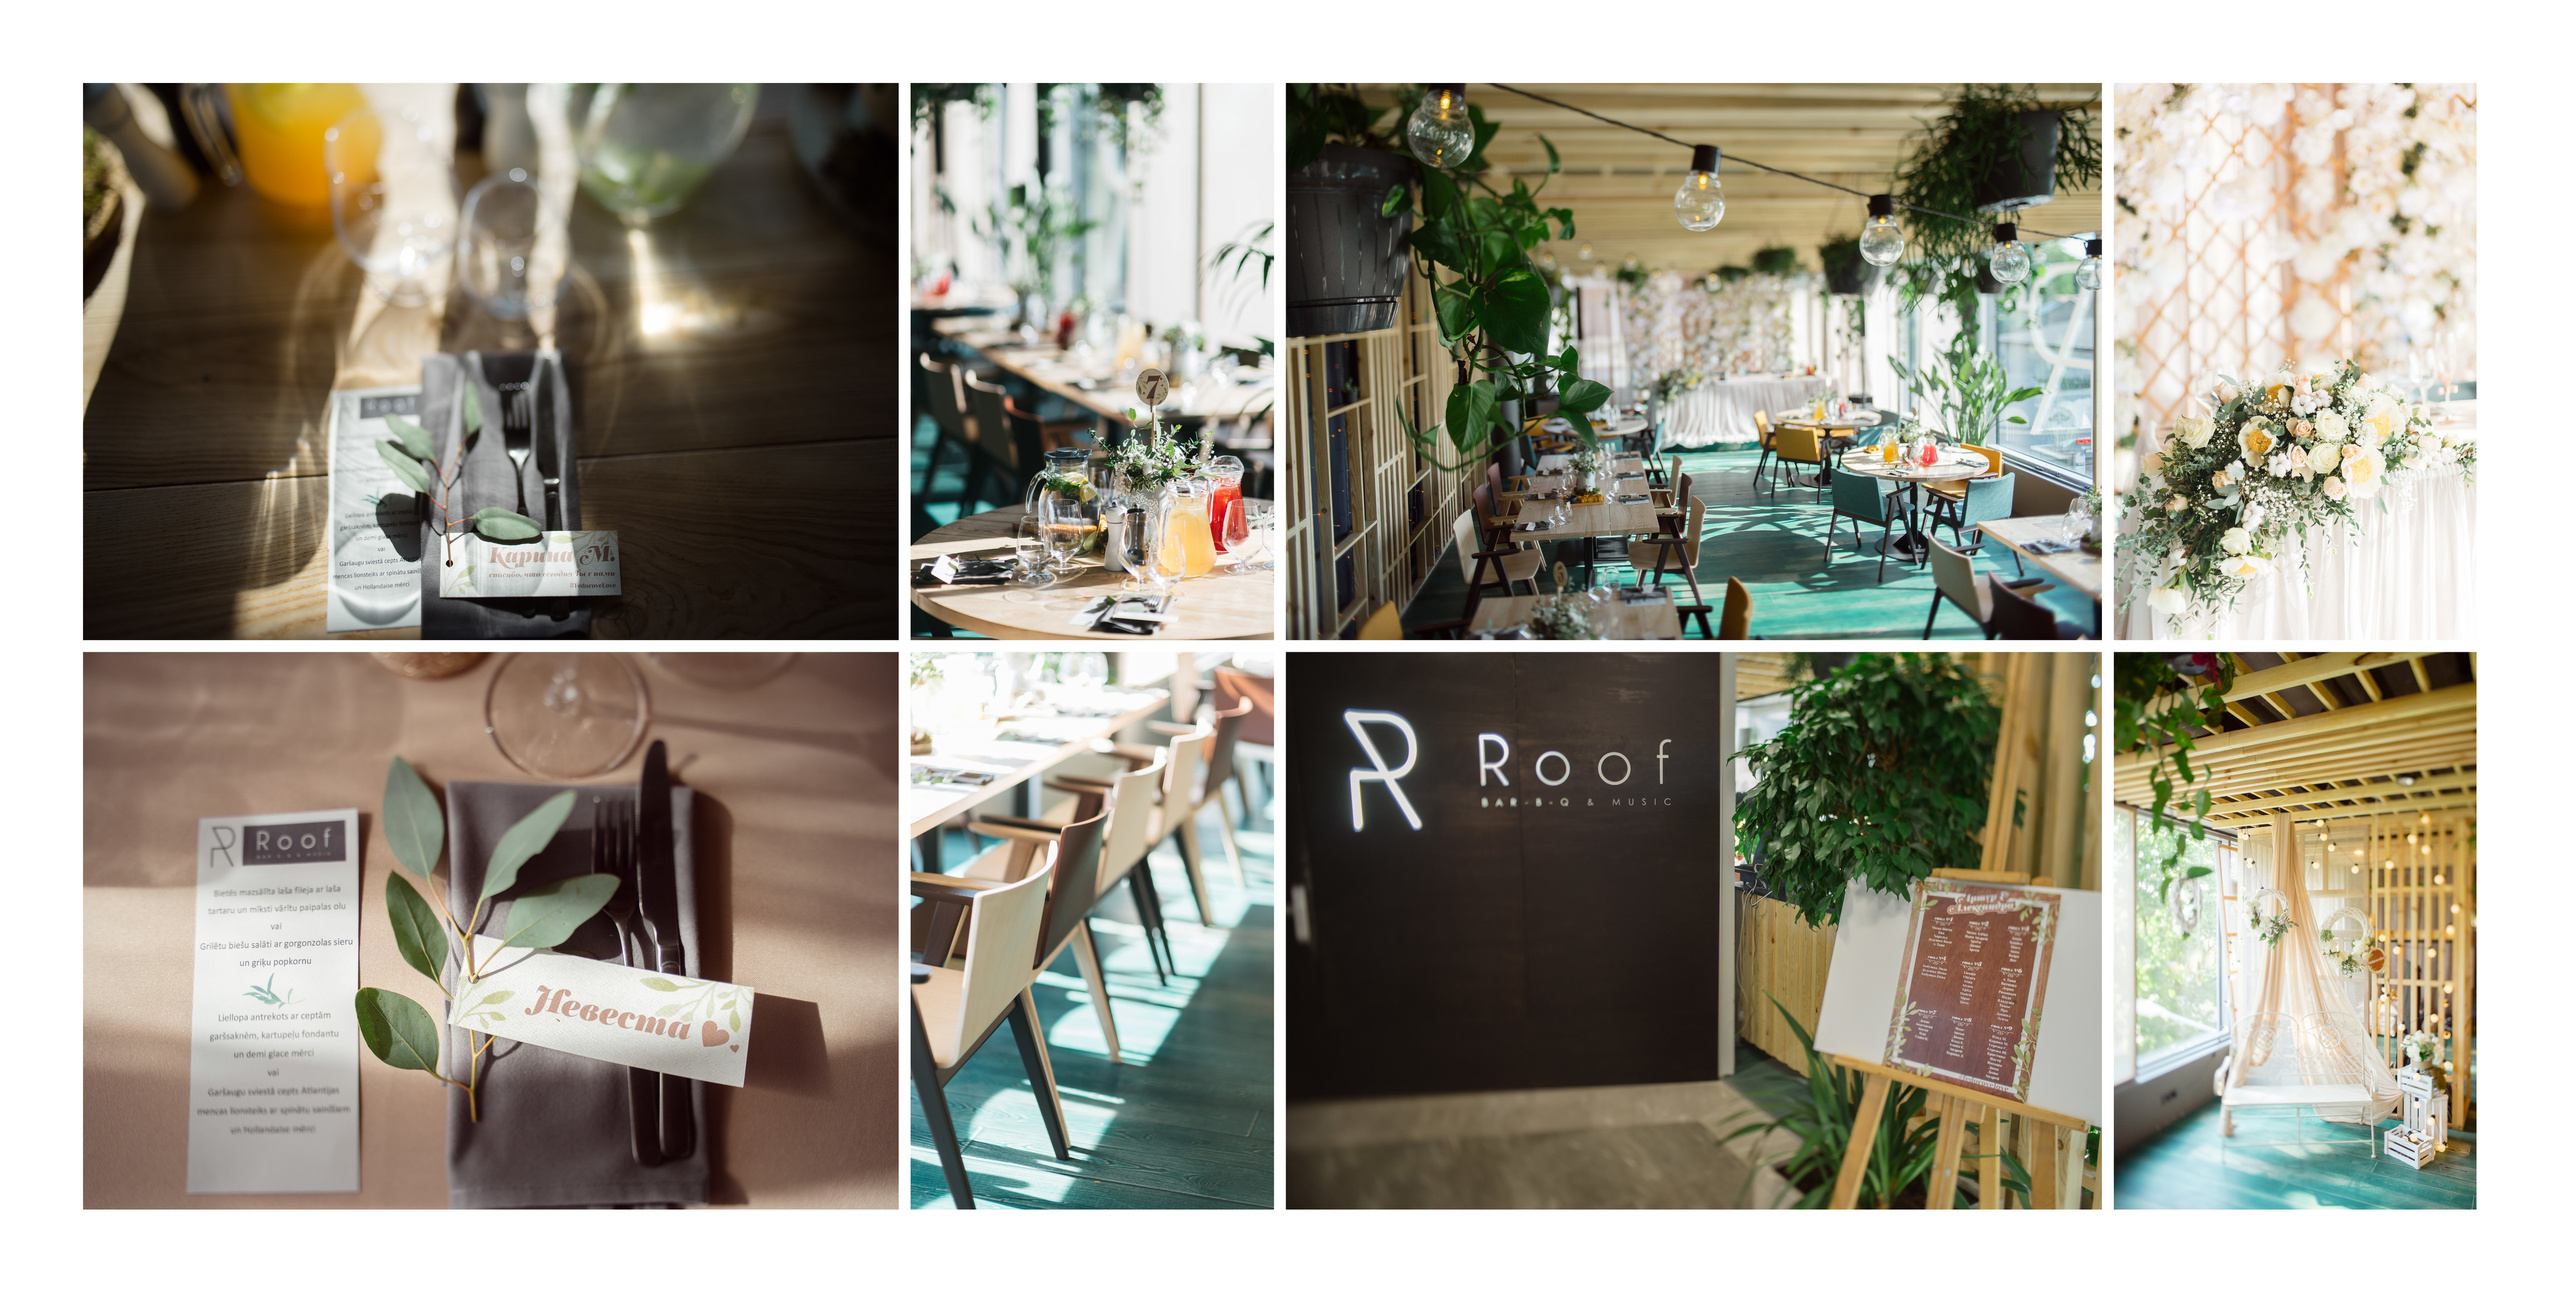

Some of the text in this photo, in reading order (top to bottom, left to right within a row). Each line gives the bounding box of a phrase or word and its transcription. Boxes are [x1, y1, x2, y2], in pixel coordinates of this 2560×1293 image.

[1146, 375, 1161, 400] 7
[489, 545, 616, 570] Карина М.
[1478, 732, 1672, 787] Roof
[1587, 798, 1594, 806] &
[1612, 797, 1672, 806] MUSIC
[256, 826, 332, 852] Roof
[278, 886, 292, 895] laša
[295, 885, 314, 896] fileja
[326, 885, 341, 893] laša
[208, 907, 235, 915] tartaru
[250, 904, 272, 913] mīksti
[275, 904, 297, 912] vārītu
[300, 902, 331, 914] paipalas
[333, 902, 346, 910] olu
[200, 941, 226, 950] Grilētu
[229, 940, 249, 949] biešu
[252, 939, 272, 949] salāti
[284, 938, 332, 949] gorgonzolas
[333, 938, 353, 946] sieru
[252, 958, 271, 968] griķu
[273, 957, 312, 970] popkornu
[218, 1013, 249, 1023] Liellopa
[250, 1013, 288, 1021] antrekots
[301, 1011, 331, 1021] ceptām
[524, 984, 692, 1041] Невеста
[210, 1030, 339, 1042] garšsaknēm, kartupeļu fondantu
[246, 1050, 266, 1058] demi
[268, 1049, 289, 1059] glace
[291, 1049, 314, 1057] mērci
